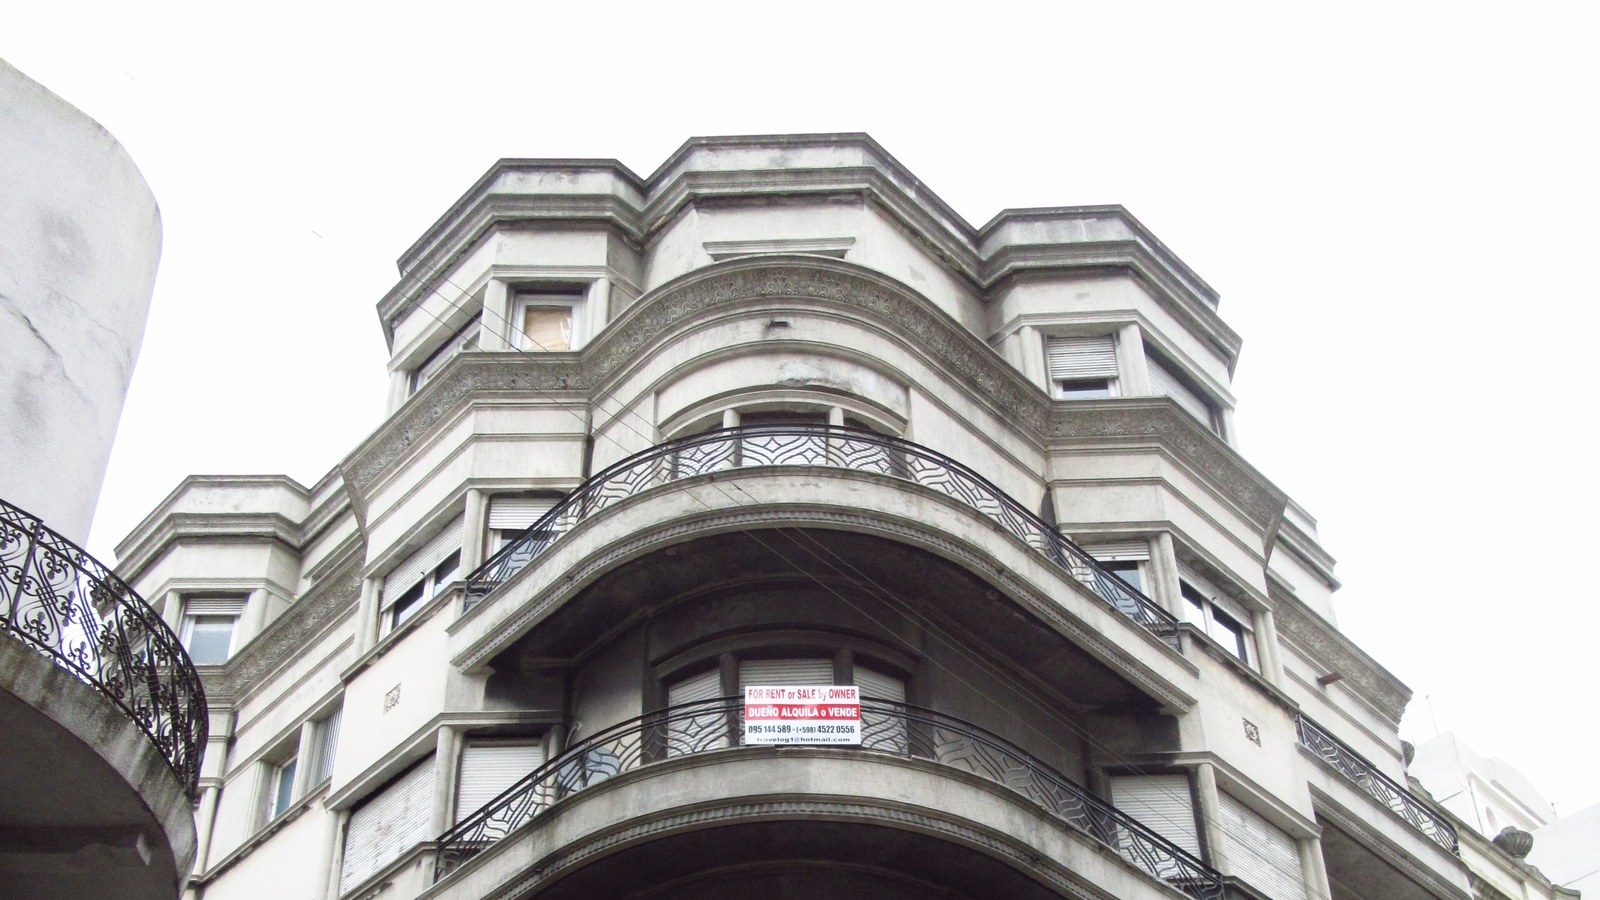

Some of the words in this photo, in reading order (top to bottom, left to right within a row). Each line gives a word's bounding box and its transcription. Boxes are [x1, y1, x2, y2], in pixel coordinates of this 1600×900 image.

[748, 689, 763, 699] FOR
[765, 689, 785, 699] RENT
[787, 691, 795, 699] or
[797, 689, 816, 699] SALE
[818, 689, 826, 701] by
[828, 689, 856, 699] OWNER
[748, 706, 779, 717] DUEÑO
[781, 707, 819, 718] ALQUILA
[828, 707, 858, 717] VENDE
[748, 725, 762, 734] 095
[764, 725, 776, 734] 144
[777, 725, 791, 734] 589
[817, 725, 835, 734] 4522
[836, 725, 855, 734] 0556
